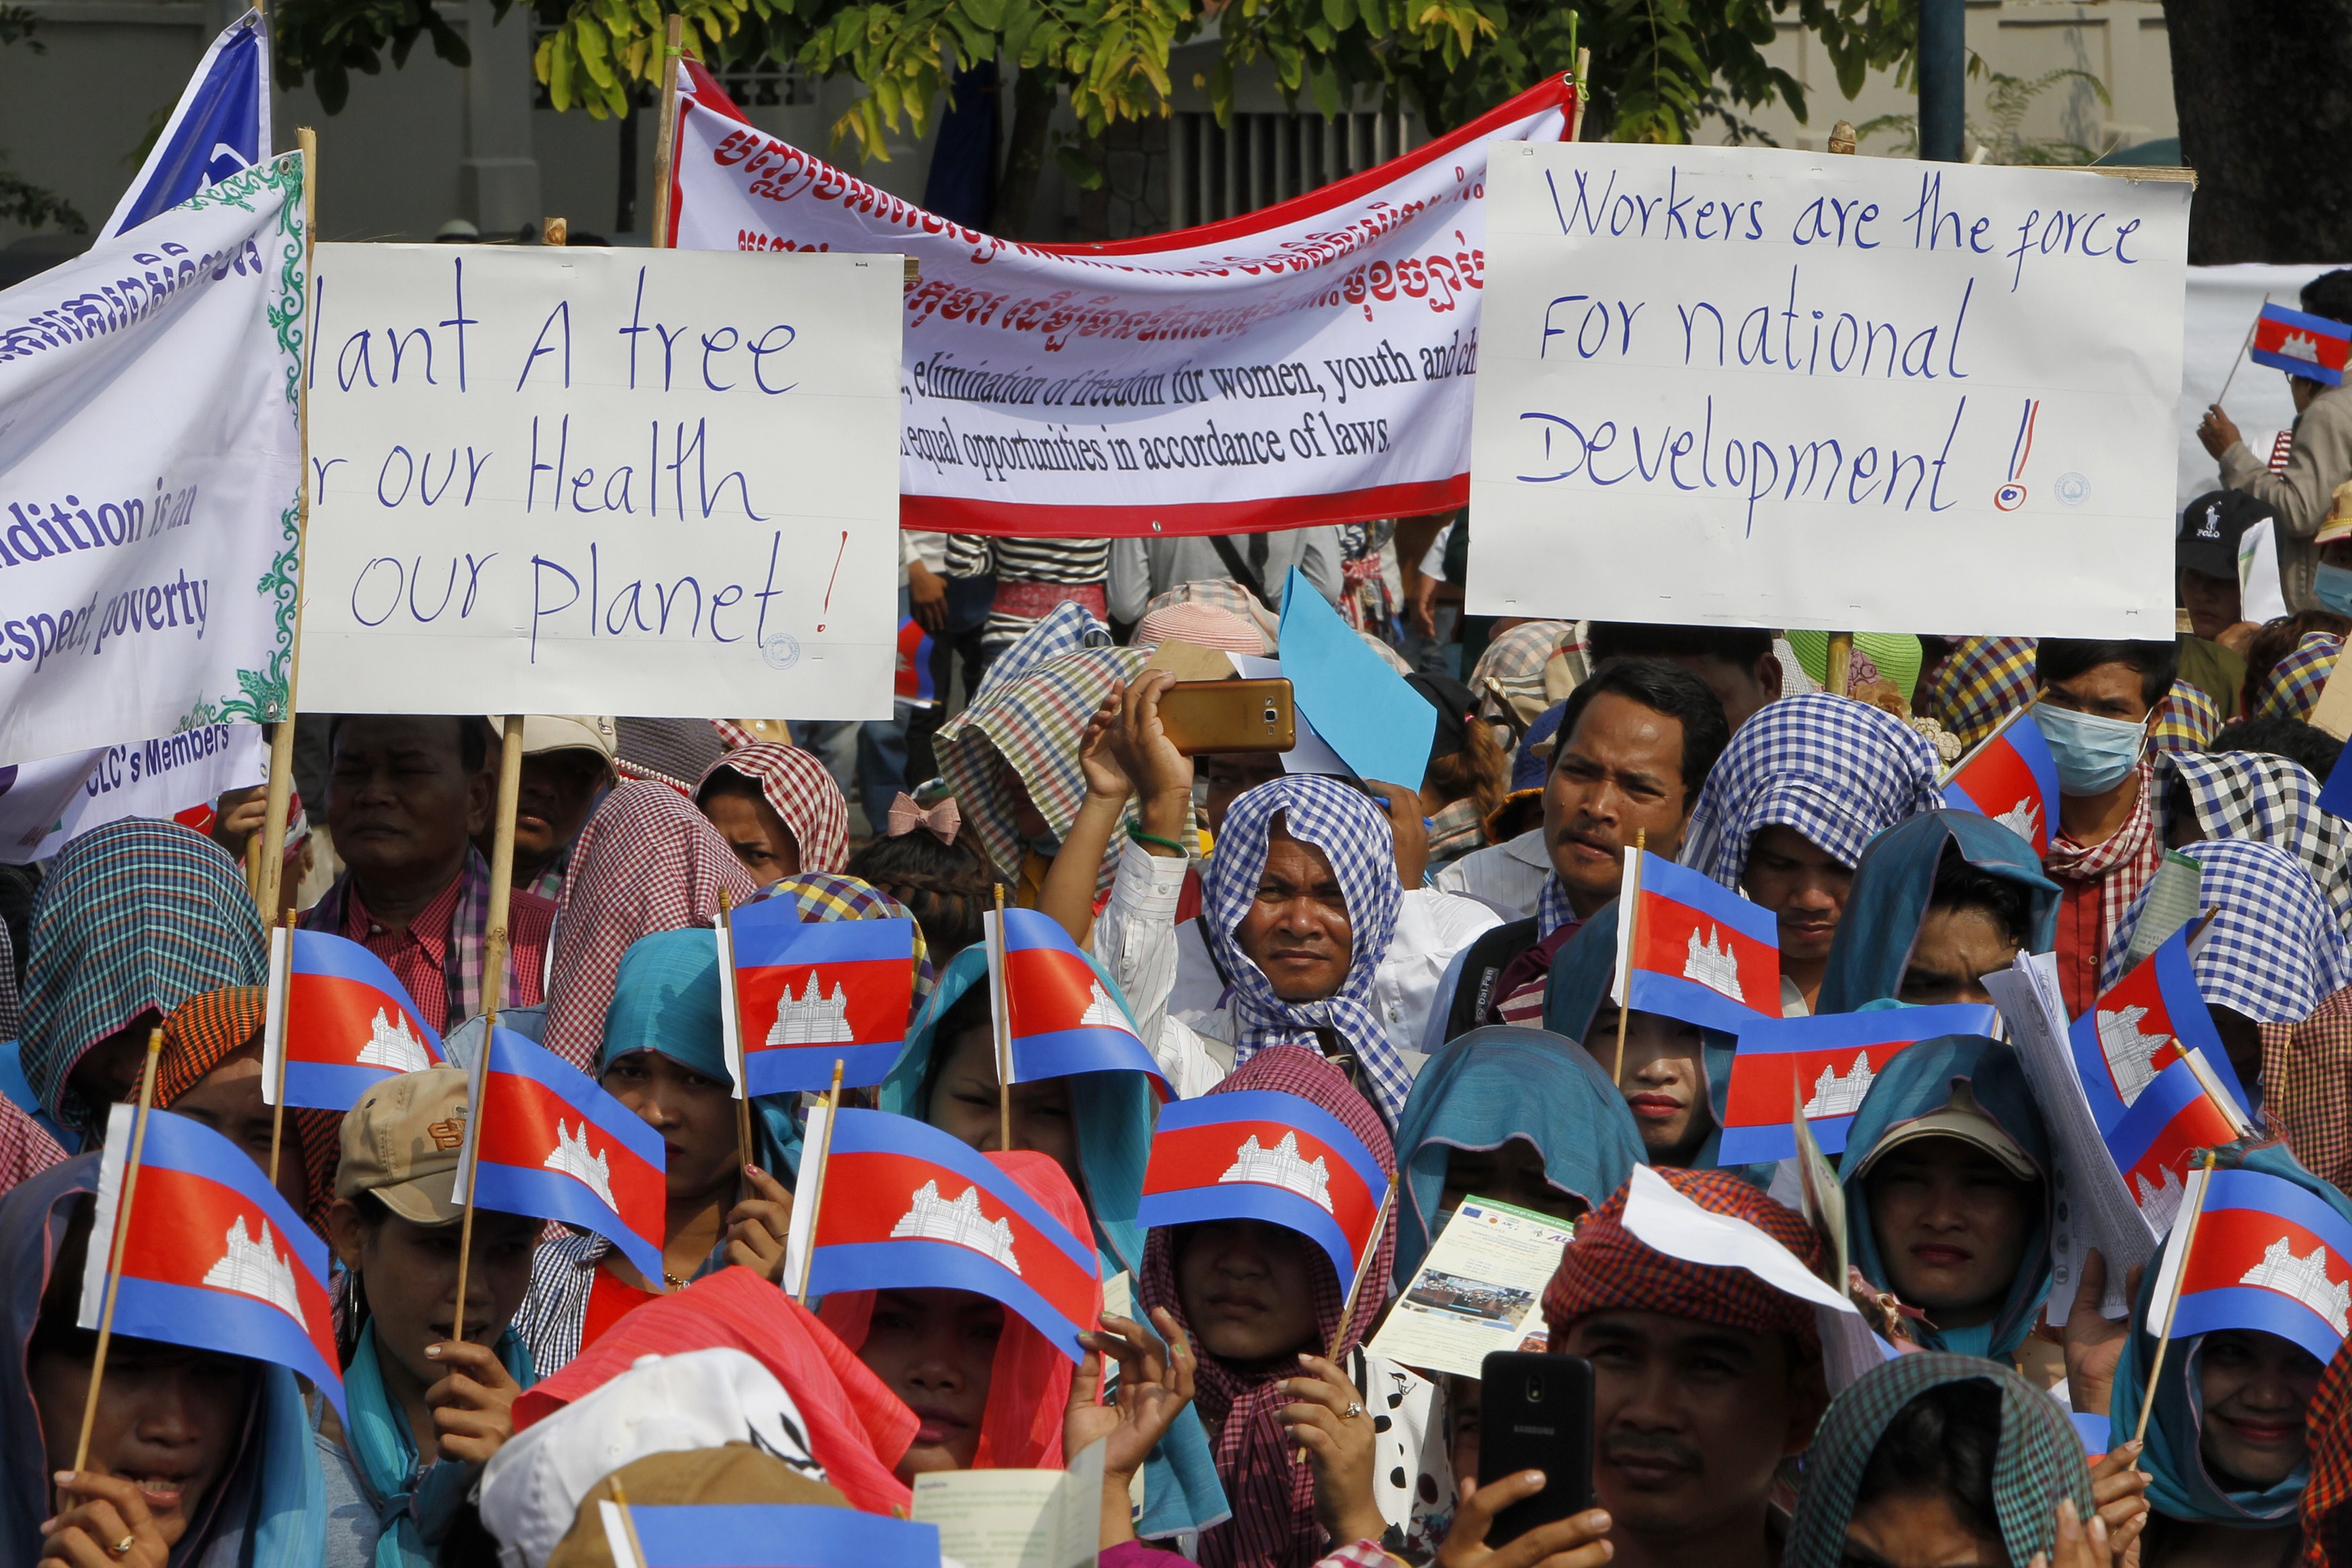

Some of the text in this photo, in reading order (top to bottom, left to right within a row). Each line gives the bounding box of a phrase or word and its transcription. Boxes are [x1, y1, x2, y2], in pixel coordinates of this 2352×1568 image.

[1546, 165, 1764, 243] Workers
[1793, 197, 1881, 249] are
[1902, 170, 1994, 254] the
[2006, 208, 2143, 293] force
[517, 300, 571, 393] A
[619, 266, 800, 395] tree
[913, 351, 1049, 405] elimination
[1042, 370, 1086, 407] of
[1070, 366, 1166, 408] freedom
[1172, 360, 1209, 404] for
[1211, 361, 1327, 403] women,
[1323, 339, 1417, 405] youth
[1419, 328, 1460, 382] and
[1677, 264, 1974, 379] national
[527, 413, 772, 522] Health
[907, 415, 964, 476] equal
[962, 423, 1109, 483] opportunities
[1100, 424, 1140, 472] in
[1138, 419, 1286, 470] accordance
[1290, 411, 1328, 461] of
[1318, 409, 1391, 457] laws.
[1516, 395, 1966, 540] Development
[148, 476, 172, 538] is
[166, 483, 198, 531] an
[2196, 528, 2220, 538] POLO
[93, 568, 208, 656] poverty
[530, 530, 784, 664] planet
[145, 724, 230, 779] Members
